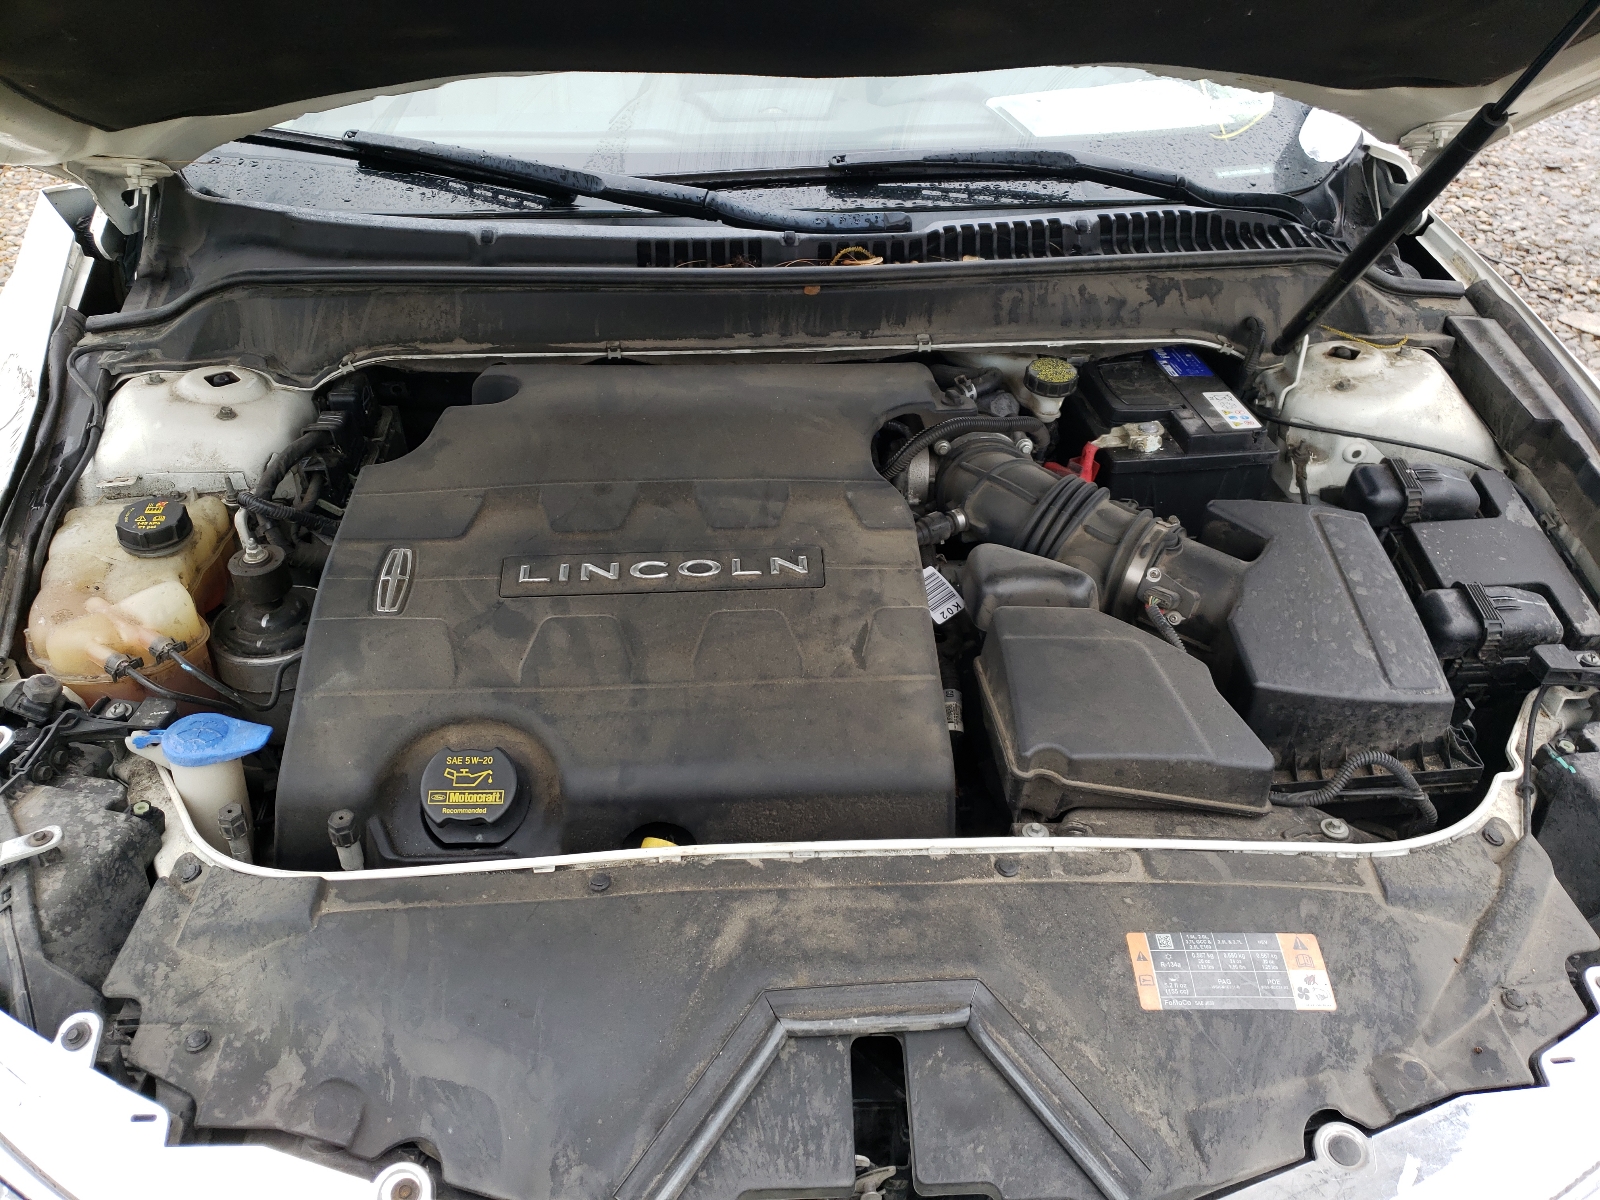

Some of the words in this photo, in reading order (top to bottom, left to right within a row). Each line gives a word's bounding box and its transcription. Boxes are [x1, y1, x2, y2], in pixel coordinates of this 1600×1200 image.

[518, 555, 809, 583] LINCOLN
[940, 601, 962, 620] K02
[446, 756, 463, 765] SAE
[465, 756, 494, 765] 5W-20
[450, 792, 499, 803] Motorcraft
